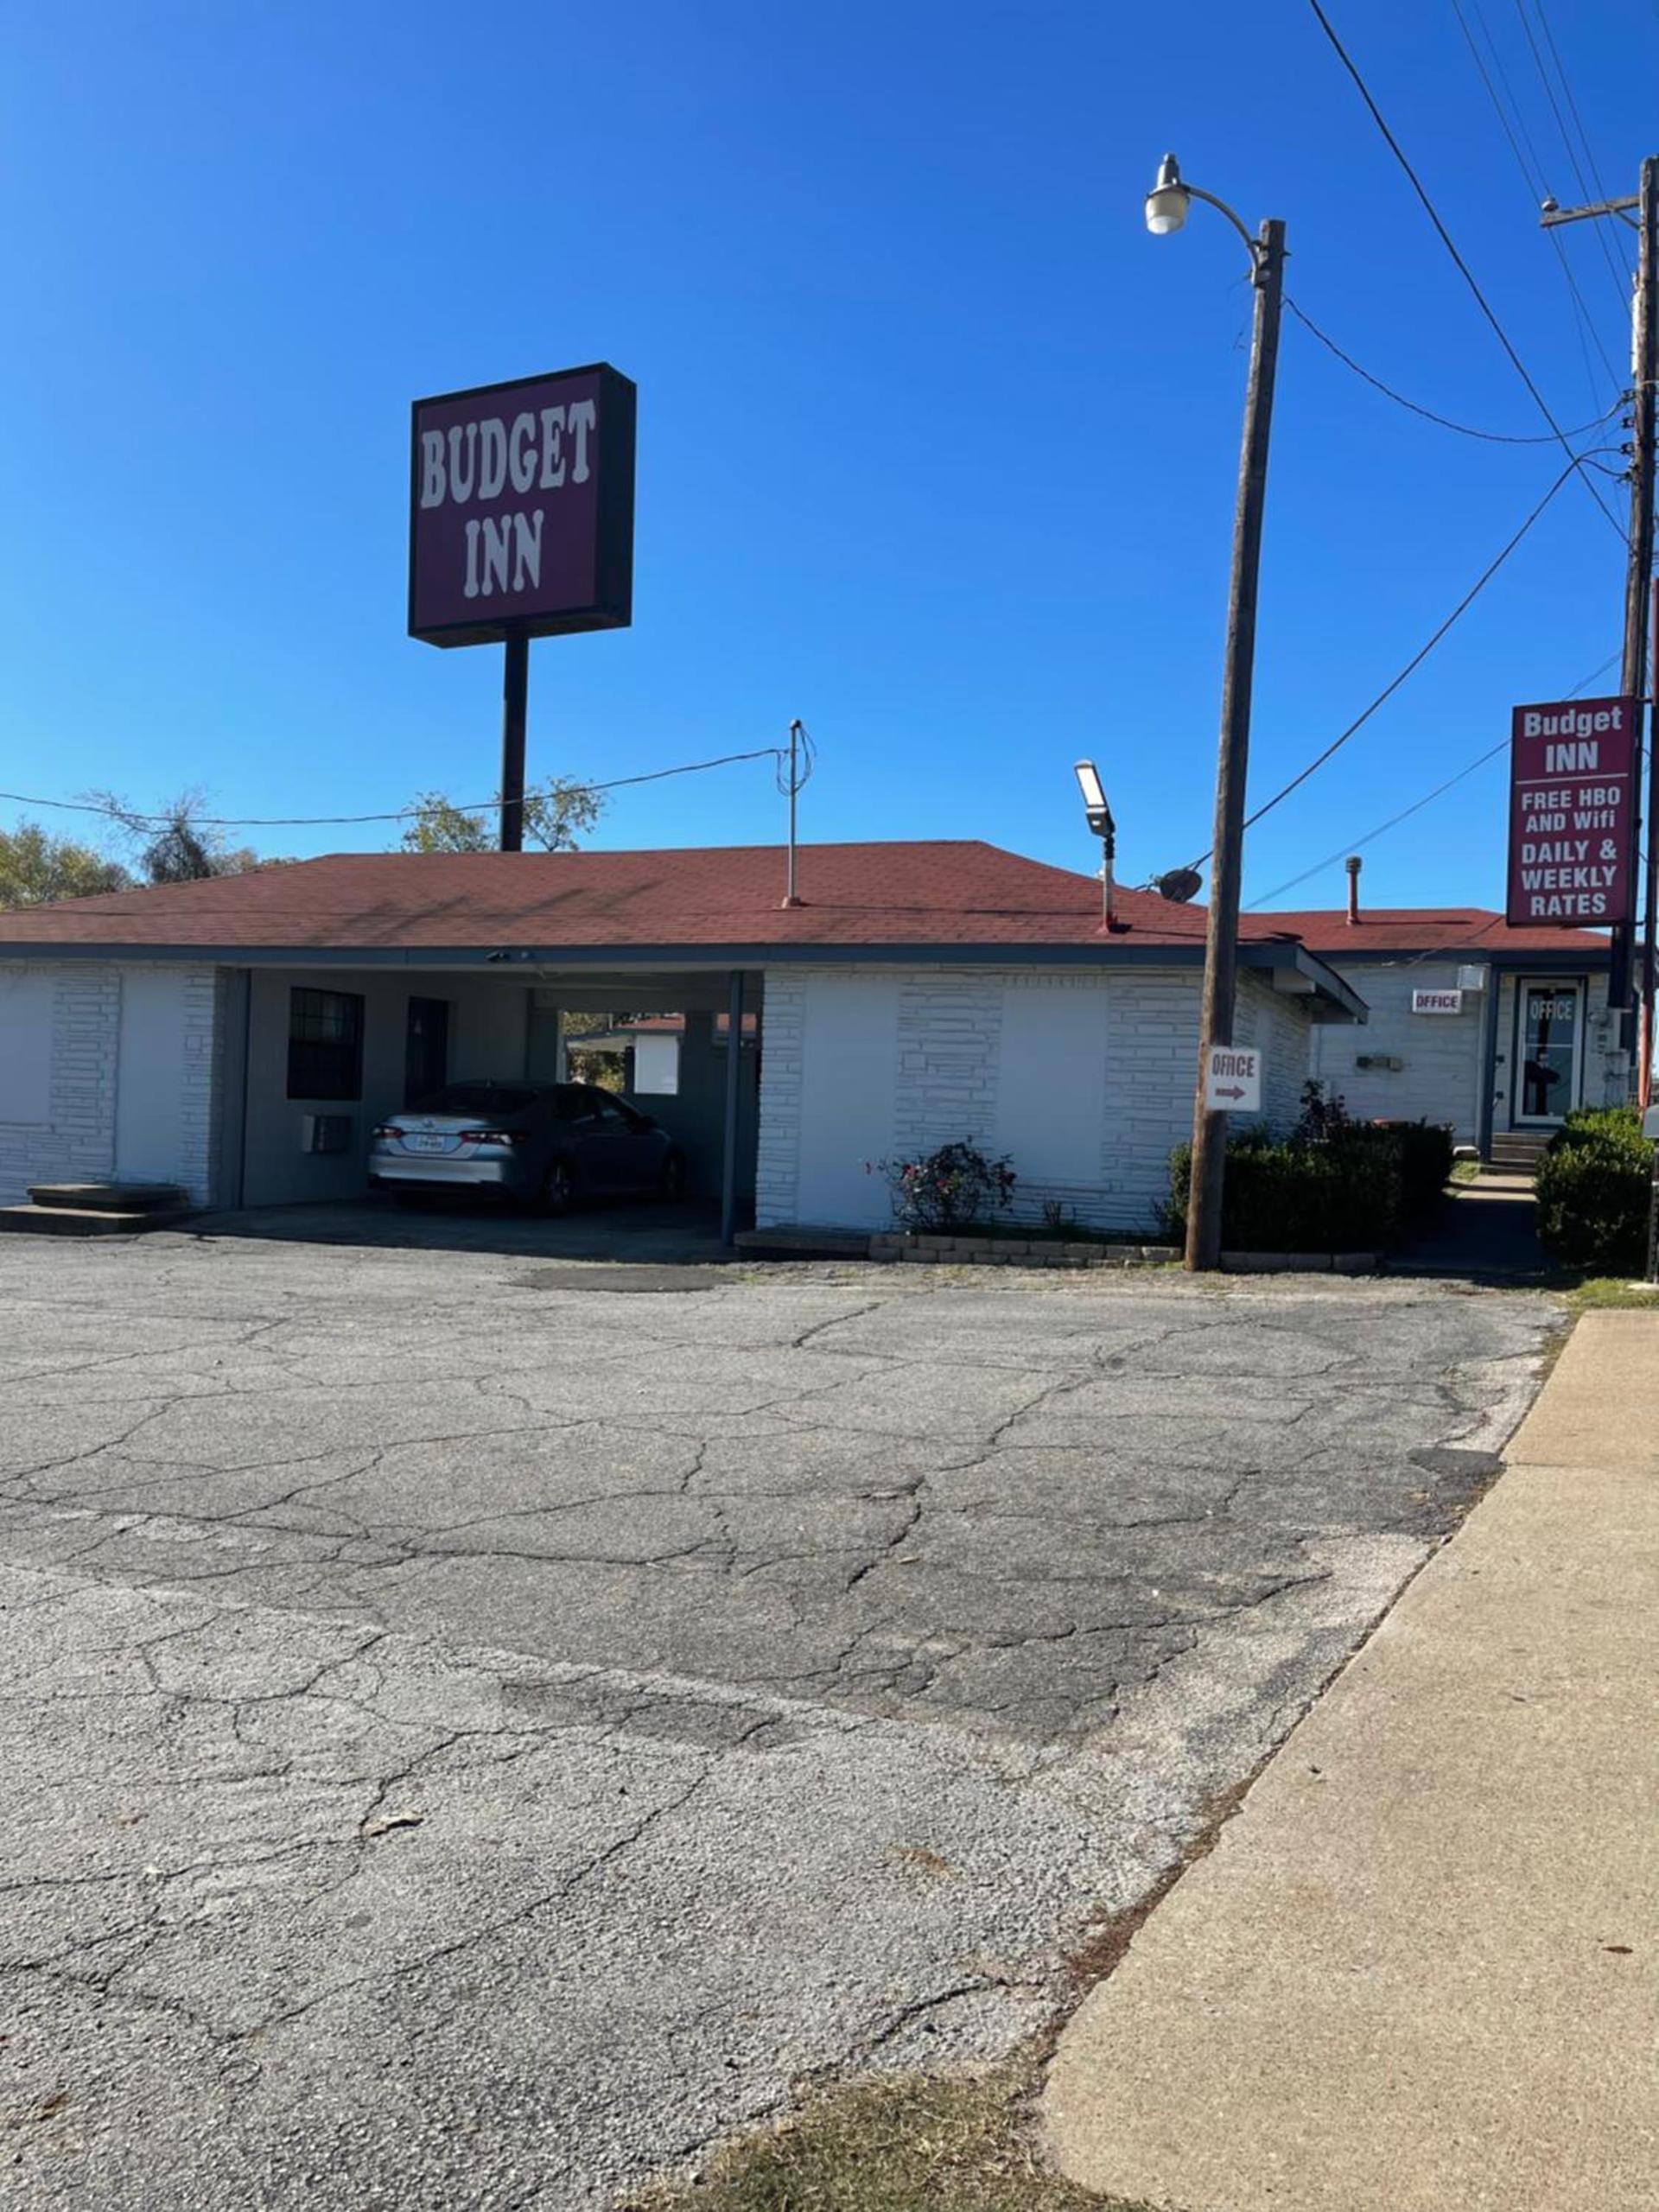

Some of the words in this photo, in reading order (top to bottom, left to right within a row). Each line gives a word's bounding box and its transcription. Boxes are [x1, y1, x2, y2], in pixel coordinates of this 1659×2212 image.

[420, 398, 596, 509] BUDGET
[463, 508, 544, 599] INN
[1523, 706, 1623, 738] Budget
[1545, 741, 1599, 772] INN
[1521, 790, 1572, 811] FREE
[1579, 786, 1621, 807] HBO
[1525, 812, 1566, 833] AND
[1573, 810, 1616, 831] Wifi
[1522, 840, 1590, 864] DAILY
[1599, 838, 1618, 860] &
[1521, 865, 1618, 891] WEEKLY
[1530, 893, 1606, 917] RATES
[1416, 995, 1459, 1009] OFFICE
[1530, 1000, 1573, 1020] OFFICE
[1212, 1053, 1255, 1078] OFFICE
